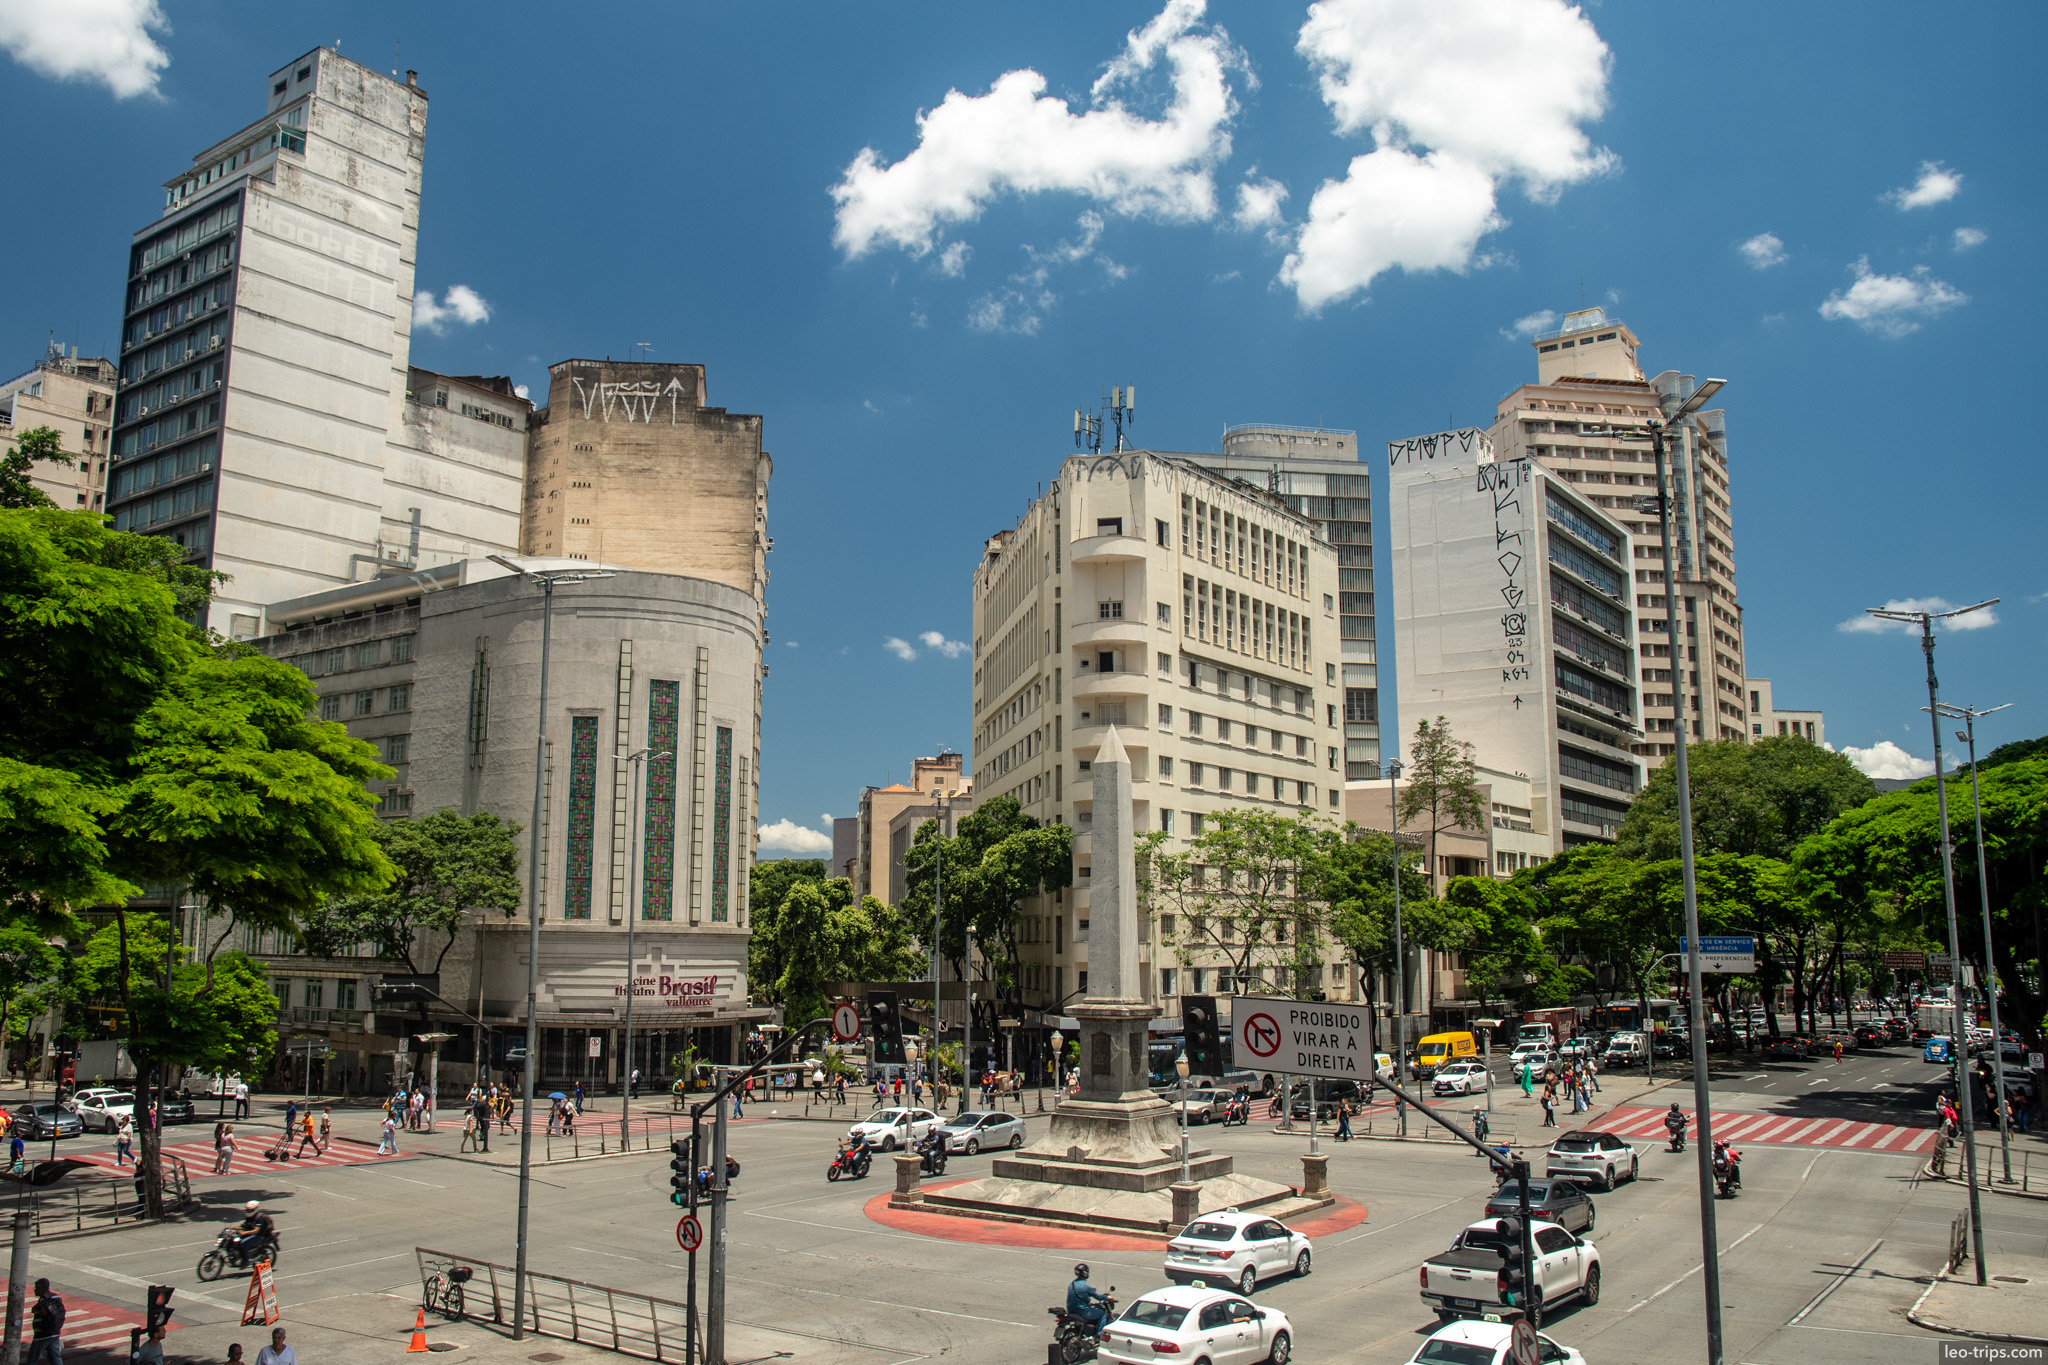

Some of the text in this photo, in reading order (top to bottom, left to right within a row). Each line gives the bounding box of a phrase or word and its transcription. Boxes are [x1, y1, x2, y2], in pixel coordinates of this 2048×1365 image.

[615, 985, 655, 996] thatro
[633, 976, 656, 986] cine
[658, 975, 718, 996] Brasil
[666, 996, 713, 1007] vallourec
[1290, 1010, 1360, 1029] PROIBIDO
[1293, 1030, 1357, 1050] VIRAR À
[1298, 1052, 1356, 1072] DIREITA
